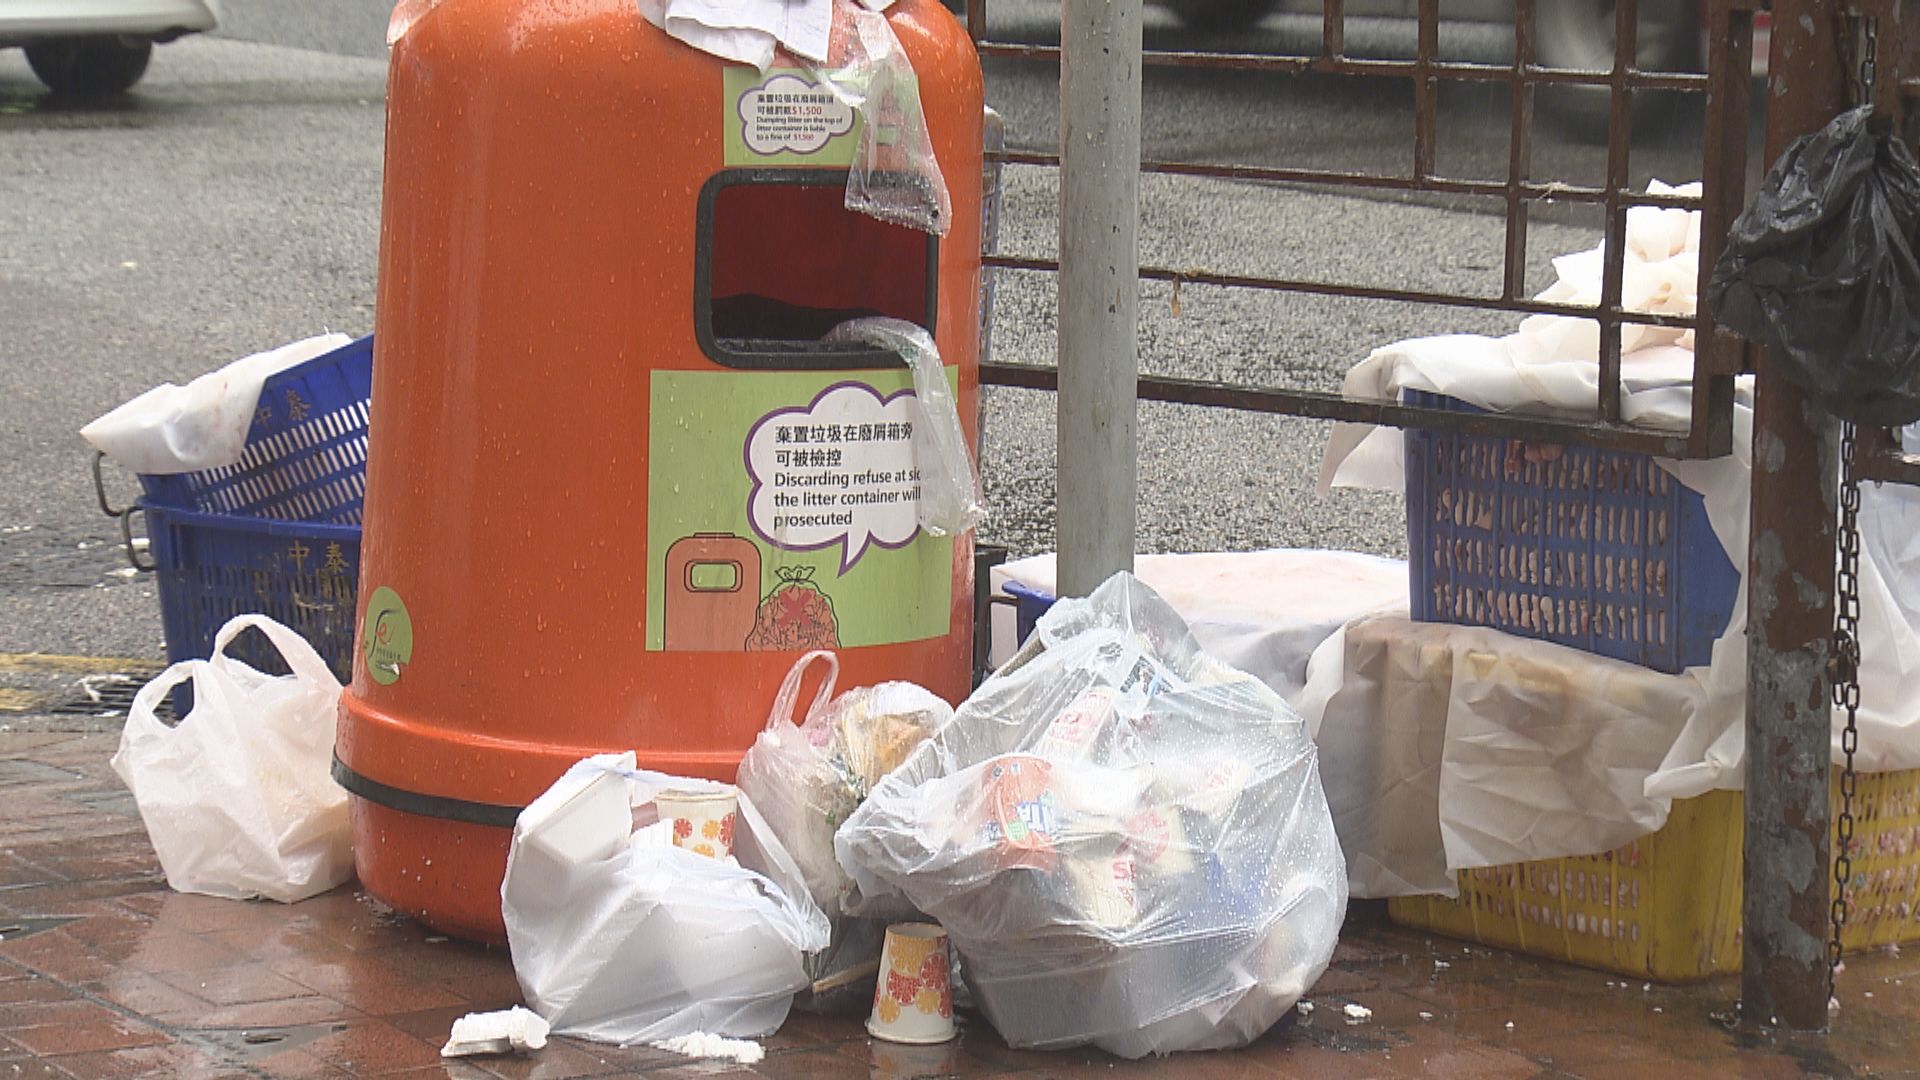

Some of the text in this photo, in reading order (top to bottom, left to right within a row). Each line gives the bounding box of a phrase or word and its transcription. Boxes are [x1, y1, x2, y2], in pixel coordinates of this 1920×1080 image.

[756, 116, 786, 125] Dumping
[825, 117, 836, 125] top
[775, 422, 913, 444] 棄置垃圾在廢屑箱旁
[775, 448, 842, 467] 可被檢控
[774, 470, 849, 489] Discarding
[853, 469, 892, 485] refuse
[895, 469, 906, 482] at
[774, 486, 921, 507] the litter container will
[774, 510, 853, 531] prosecuted
